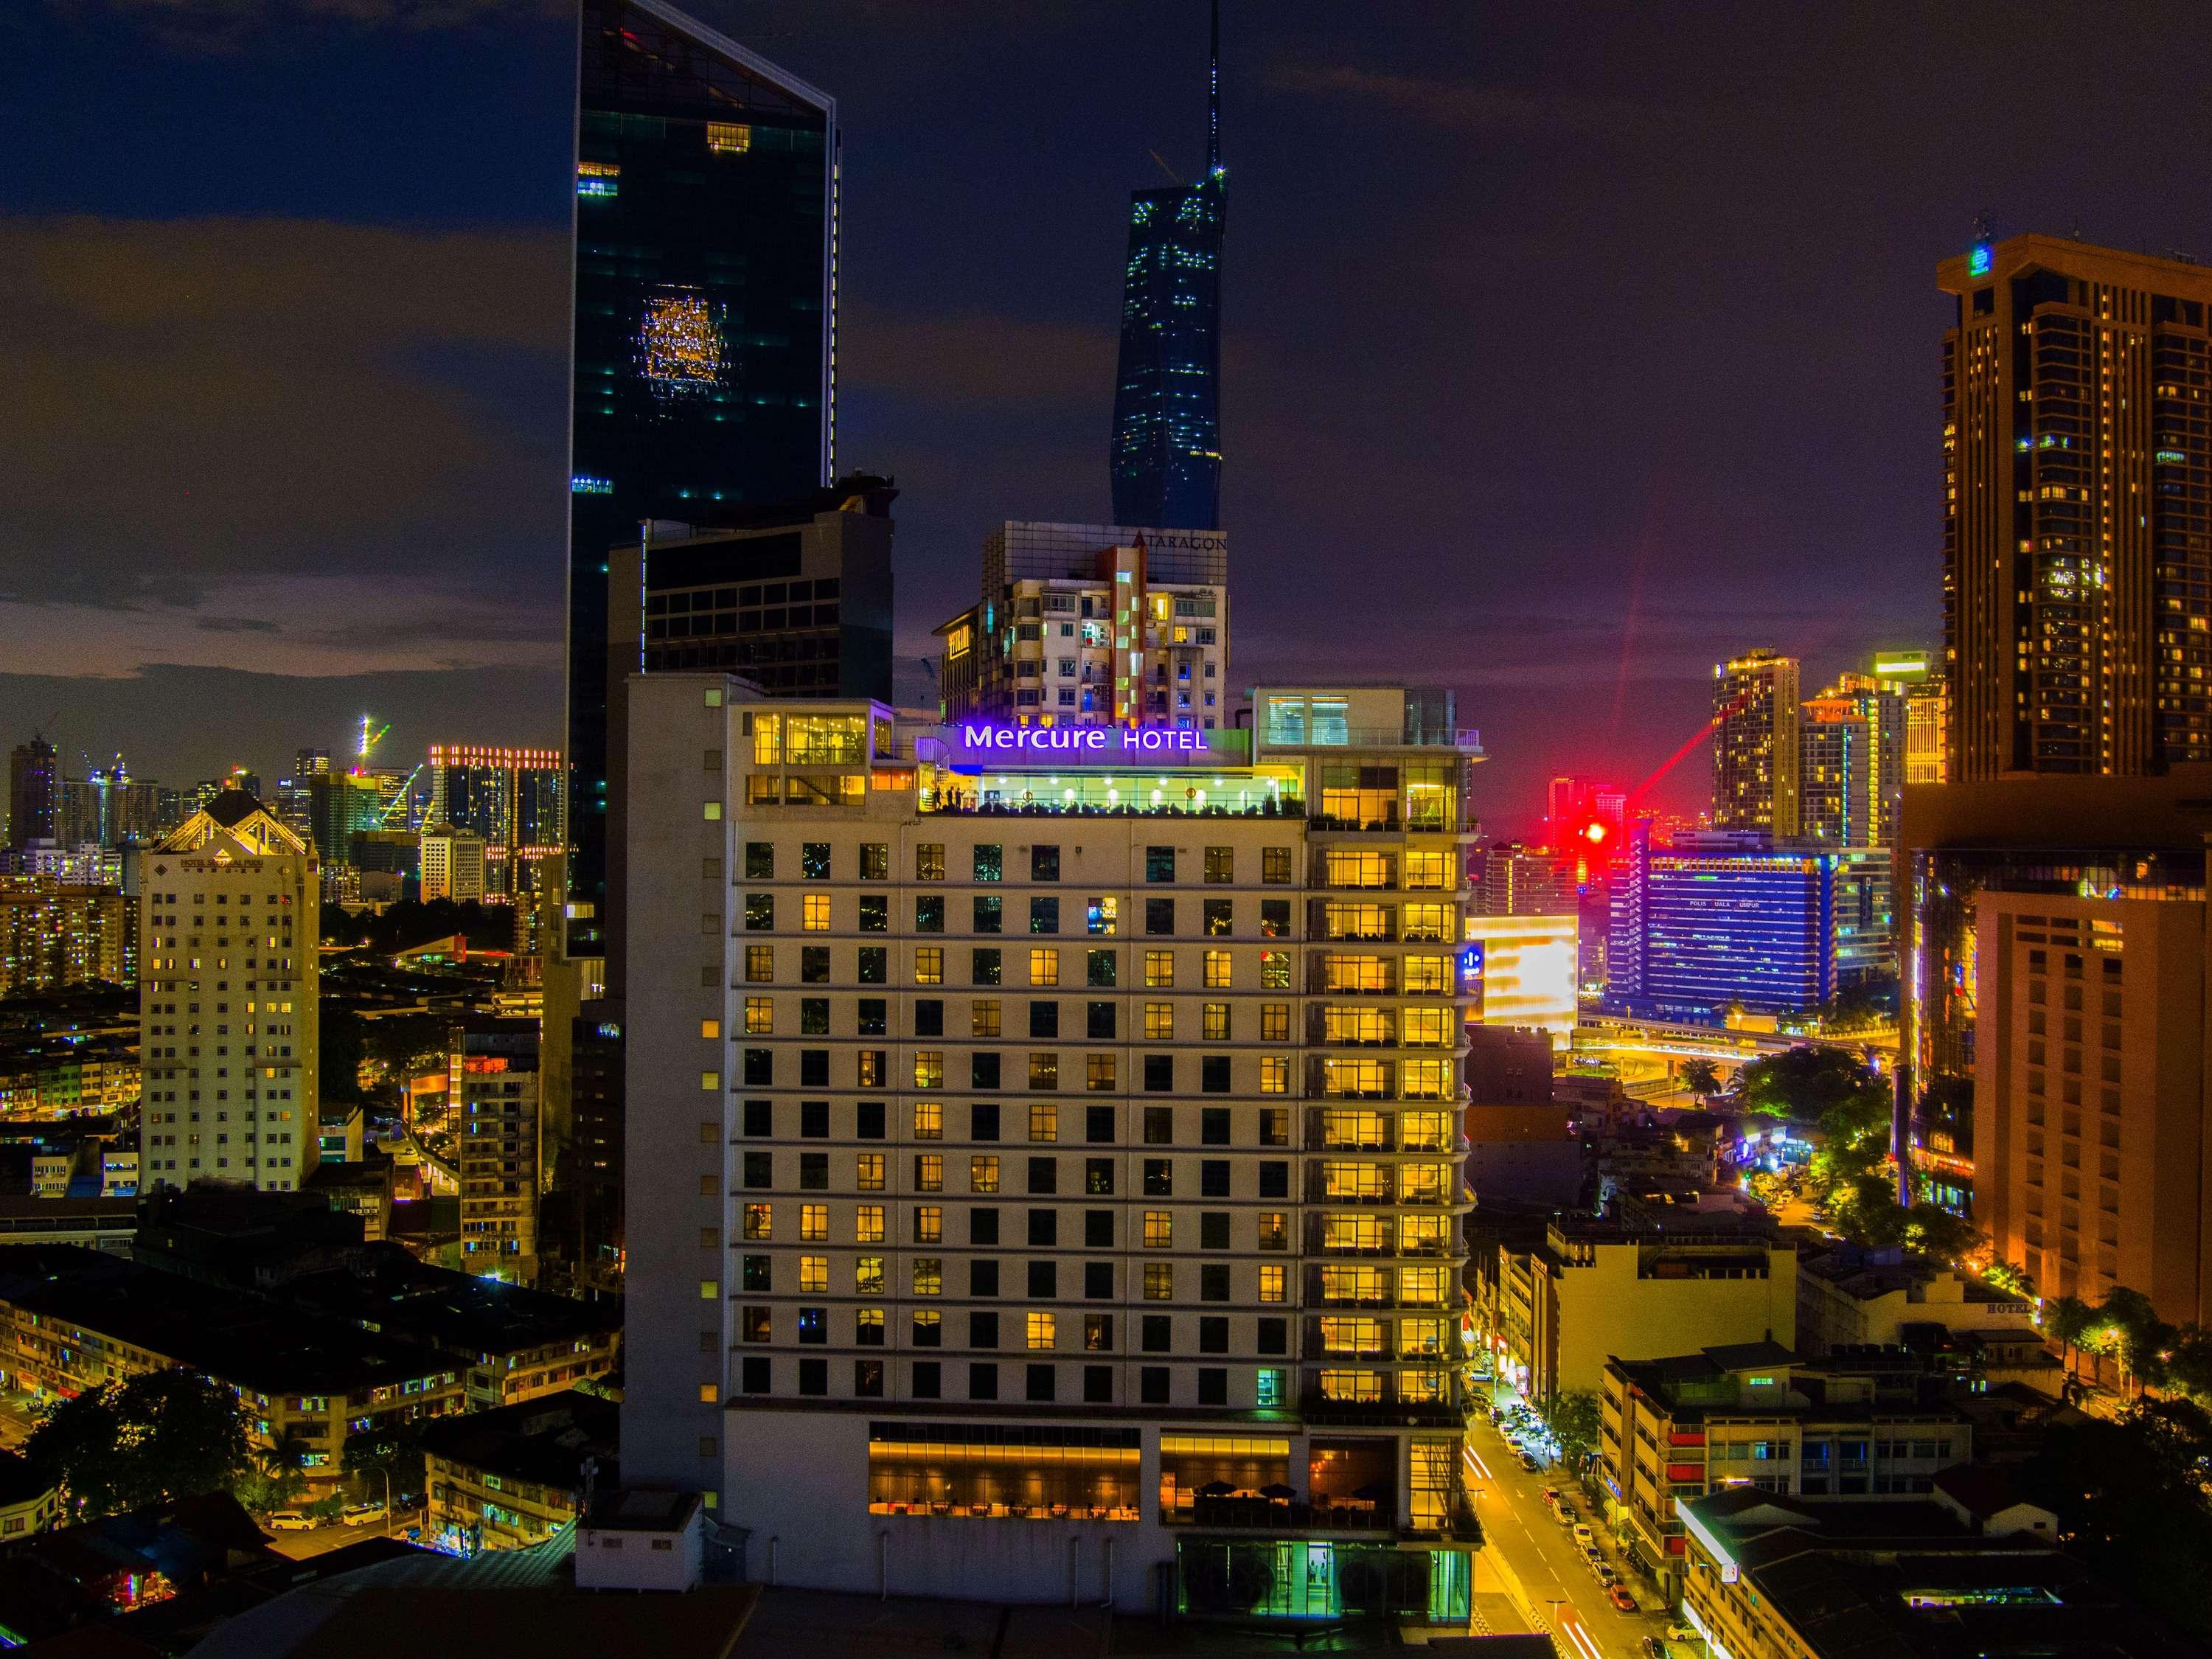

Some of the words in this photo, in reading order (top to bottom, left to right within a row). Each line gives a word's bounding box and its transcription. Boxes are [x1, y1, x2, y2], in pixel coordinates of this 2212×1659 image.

[964, 726, 1106, 749] Mercure
[1123, 730, 1208, 750] HOTEL
[1986, 1303, 2031, 1314] HOTEL
